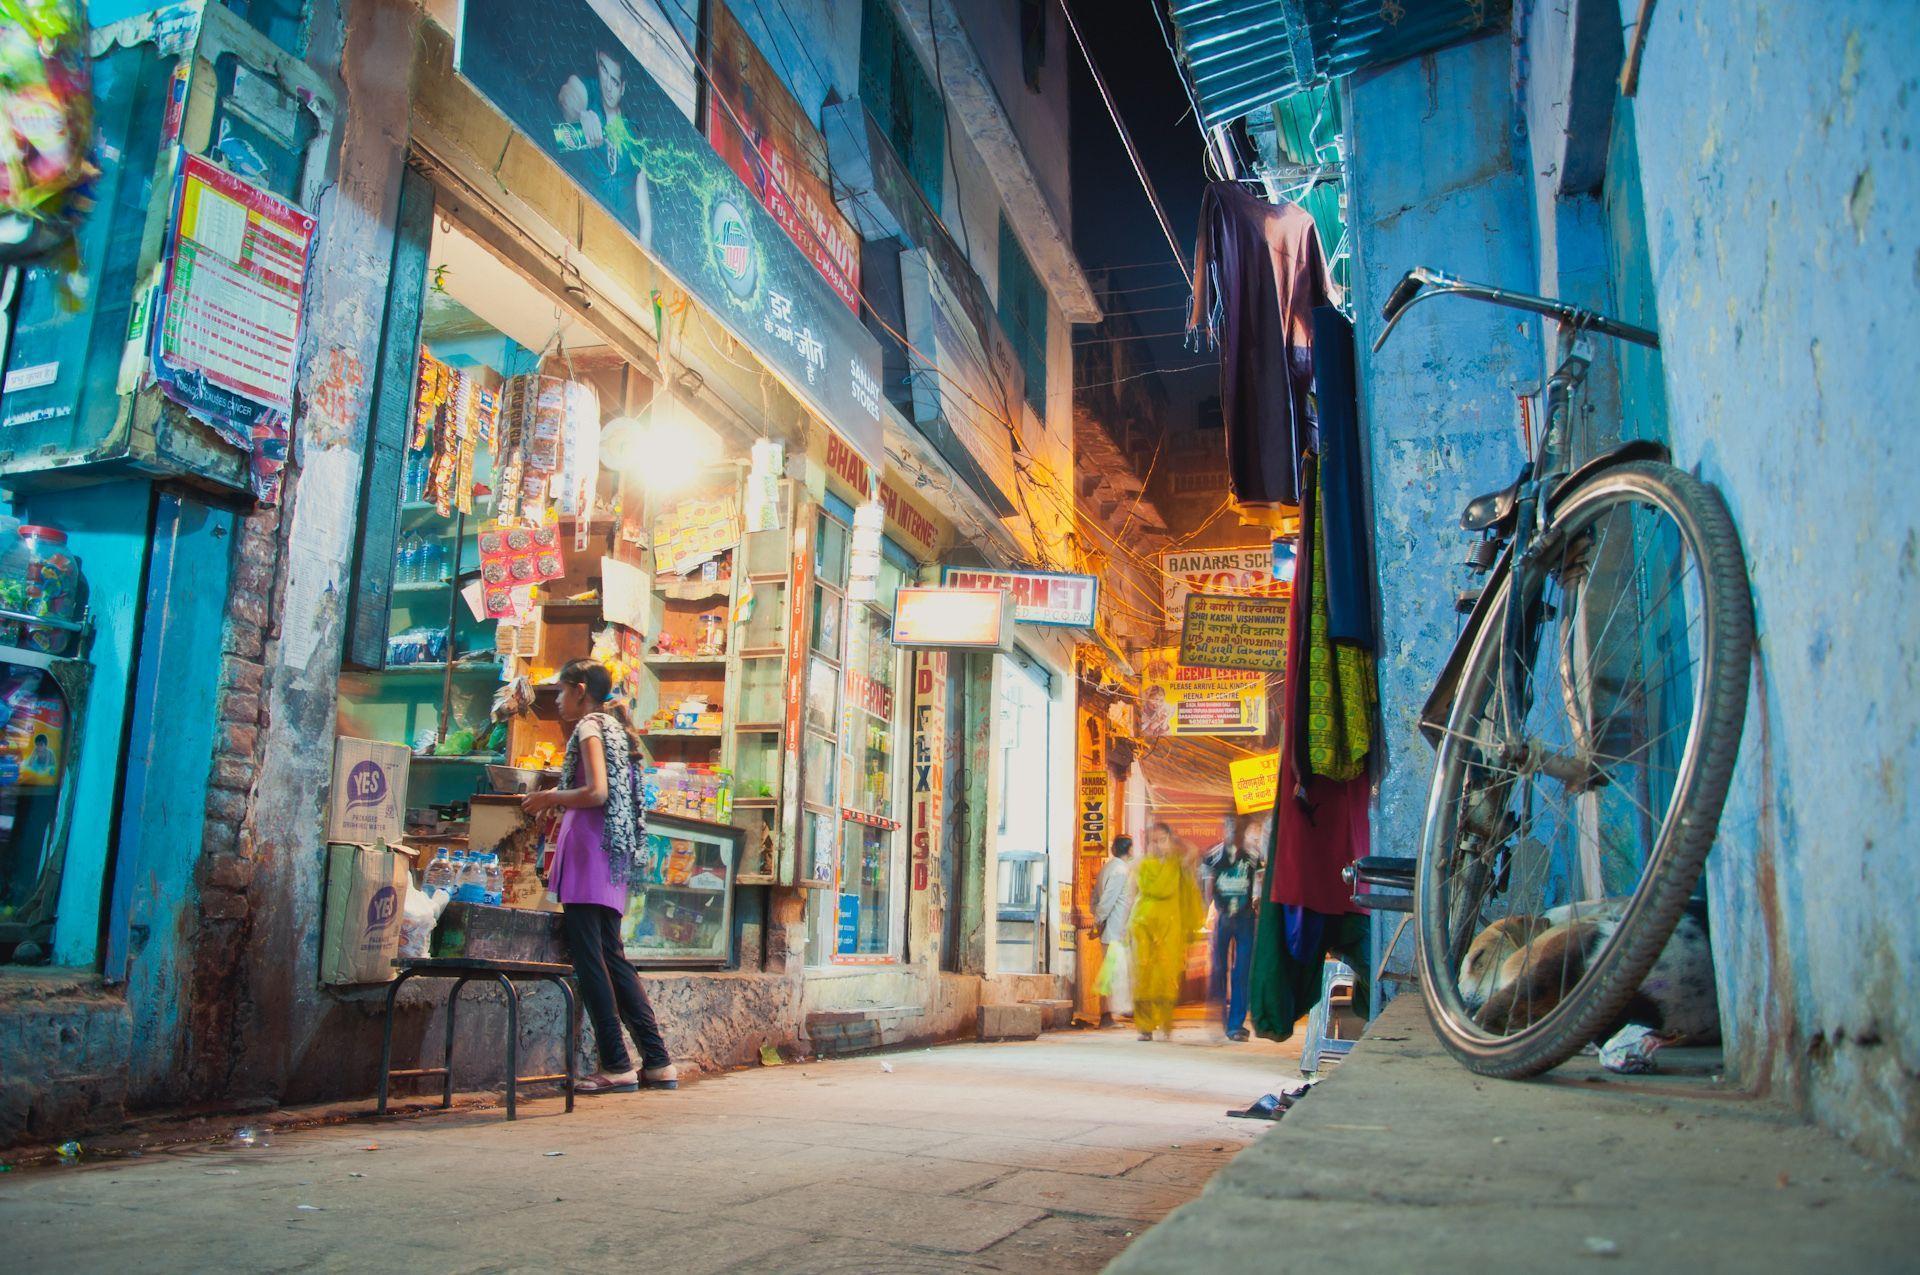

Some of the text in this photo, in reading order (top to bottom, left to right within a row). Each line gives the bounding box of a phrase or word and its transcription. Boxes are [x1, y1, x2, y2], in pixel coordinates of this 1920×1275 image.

[771, 196, 855, 304] FULL FULL MASALA
[768, 290, 792, 323] डर
[763, 314, 825, 370] के आगे जीत
[851, 359, 880, 401] SANJAY
[851, 381, 880, 421] STORES
[827, 432, 899, 521] BHAVSH
[1169, 554, 1239, 572] BANARAS
[949, 573, 1087, 610] INTERNET
[1073, 611, 1091, 622] FAX
[1189, 612, 1209, 621] SHRI
[1210, 613, 1233, 623] KASHI
[1236, 615, 1287, 624] VISHWANATH
[1210, 601, 1235, 613] काशी
[1176, 667, 1212, 680] HEENA
[354, 770, 379, 797] YES
[1082, 776, 1107, 786] BANARAS
[1082, 786, 1105, 796] SCHOOL
[368, 823, 386, 831] WATER
[1083, 801, 1104, 842] YOGA
[374, 894, 395, 920] YES
